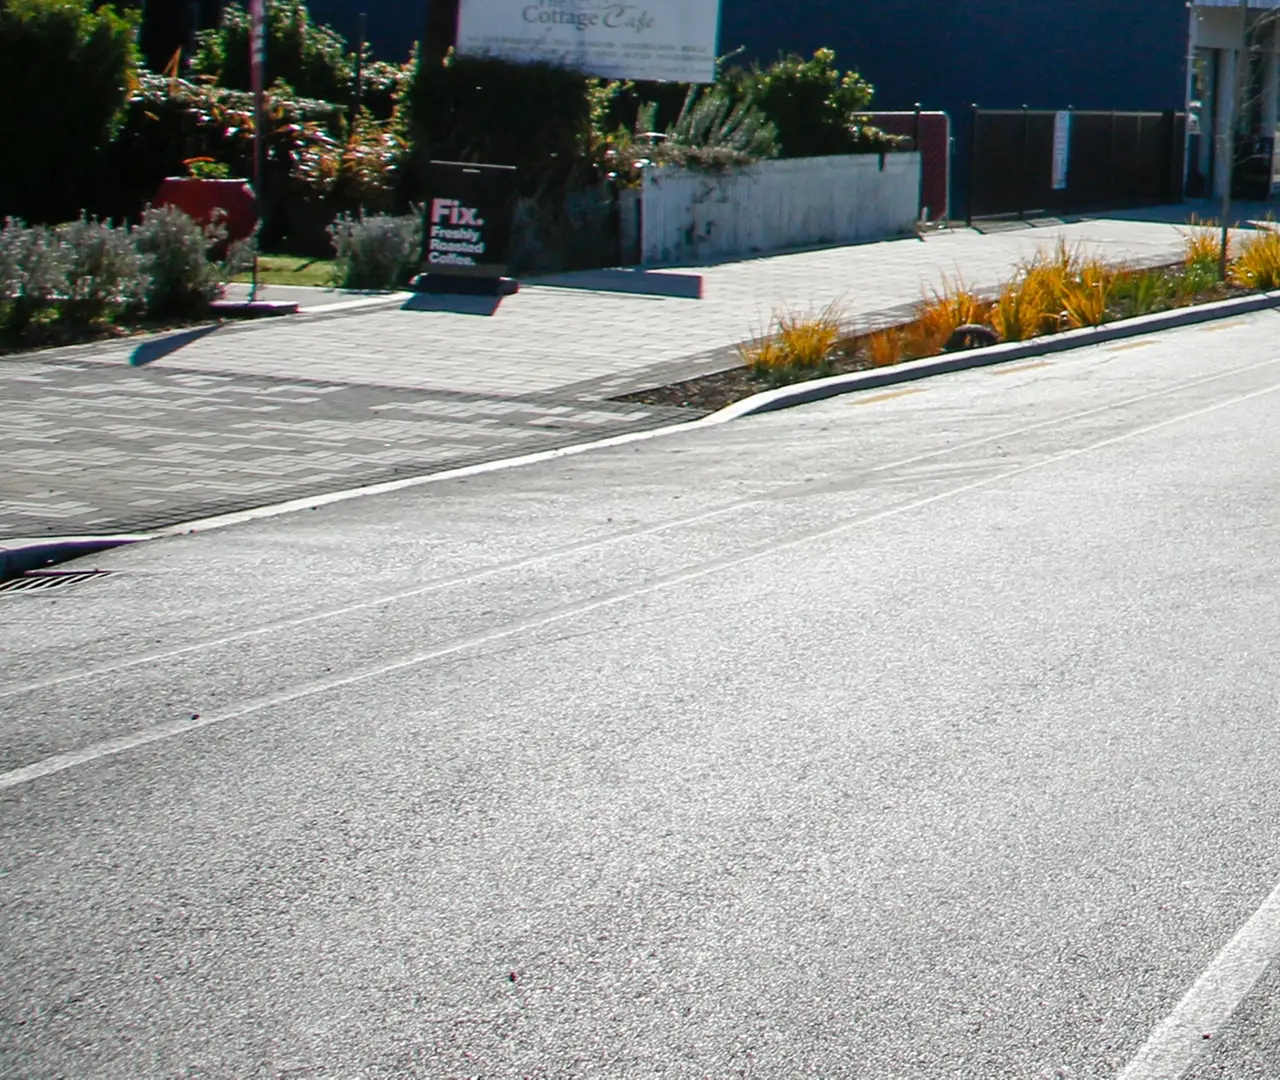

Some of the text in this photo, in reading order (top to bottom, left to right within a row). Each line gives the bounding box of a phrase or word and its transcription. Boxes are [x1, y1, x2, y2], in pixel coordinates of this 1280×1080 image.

[521, 4, 599, 30] Cottage
[431, 198, 485, 226] Fix.
[430, 226, 480, 242] Freshly
[430, 239, 485, 254] Roasted
[428, 252, 477, 266] Coffee.
